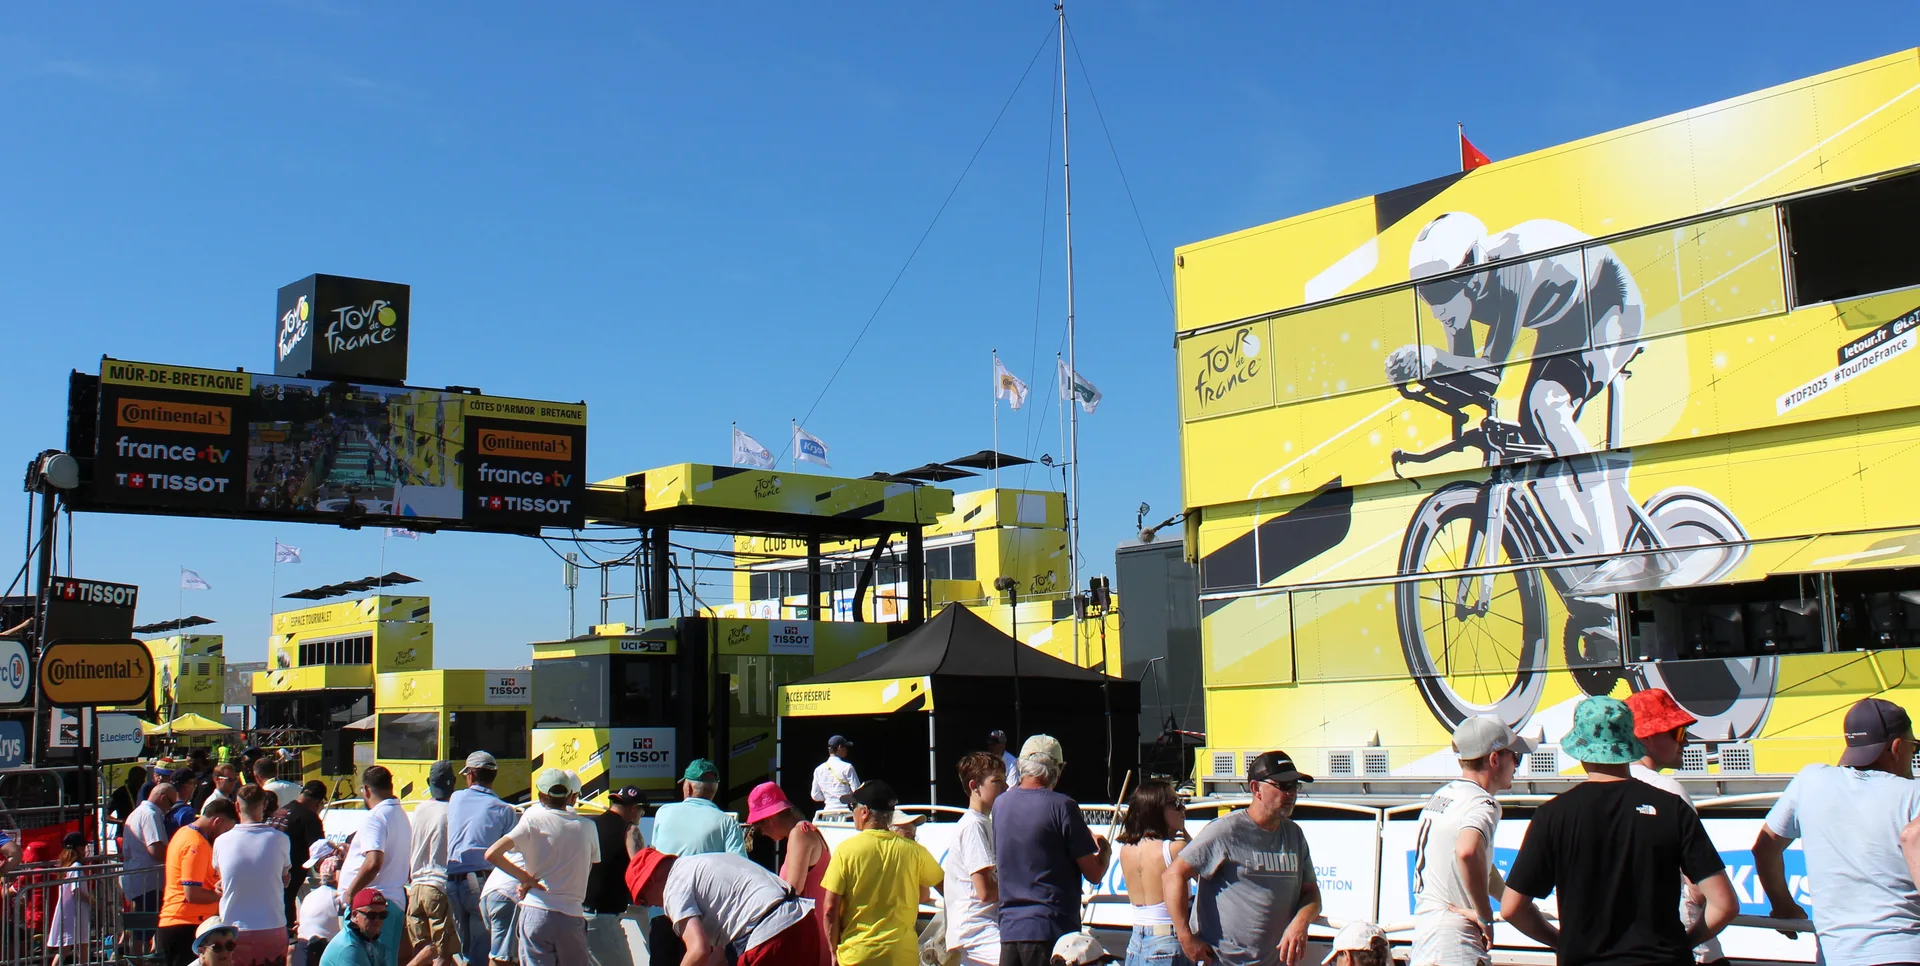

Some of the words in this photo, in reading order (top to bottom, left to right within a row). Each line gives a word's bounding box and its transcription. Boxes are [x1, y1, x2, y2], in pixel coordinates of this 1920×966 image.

[1844, 329, 1888, 359] letour.fr
[109, 365, 244, 390] MÛR-DE-BRETAGNE
[1784, 377, 1828, 408] #TDF2025
[1834, 339, 1908, 382] #TourDeFrance
[122, 404, 212, 425] Continental
[470, 400, 495, 412] CÔTES
[496, 404, 536, 415] D'ARMOR
[541, 408, 582, 419] BRETAGNE
[482, 433, 556, 453] Continental
[148, 474, 229, 492] TISSOT
[504, 497, 571, 513] TISSOT
[764, 537, 787, 552] CLUB
[78, 583, 136, 606] TISSOT
[621, 642, 638, 650] UCI
[773, 635, 809, 644] TISSOT
[48, 658, 131, 685] Continental
[489, 687, 527, 695] TISSOT
[803, 688, 831, 701] RÉSERVÉ
[616, 751, 670, 763] TISSOT
[1253, 851, 1298, 872] PUMA
